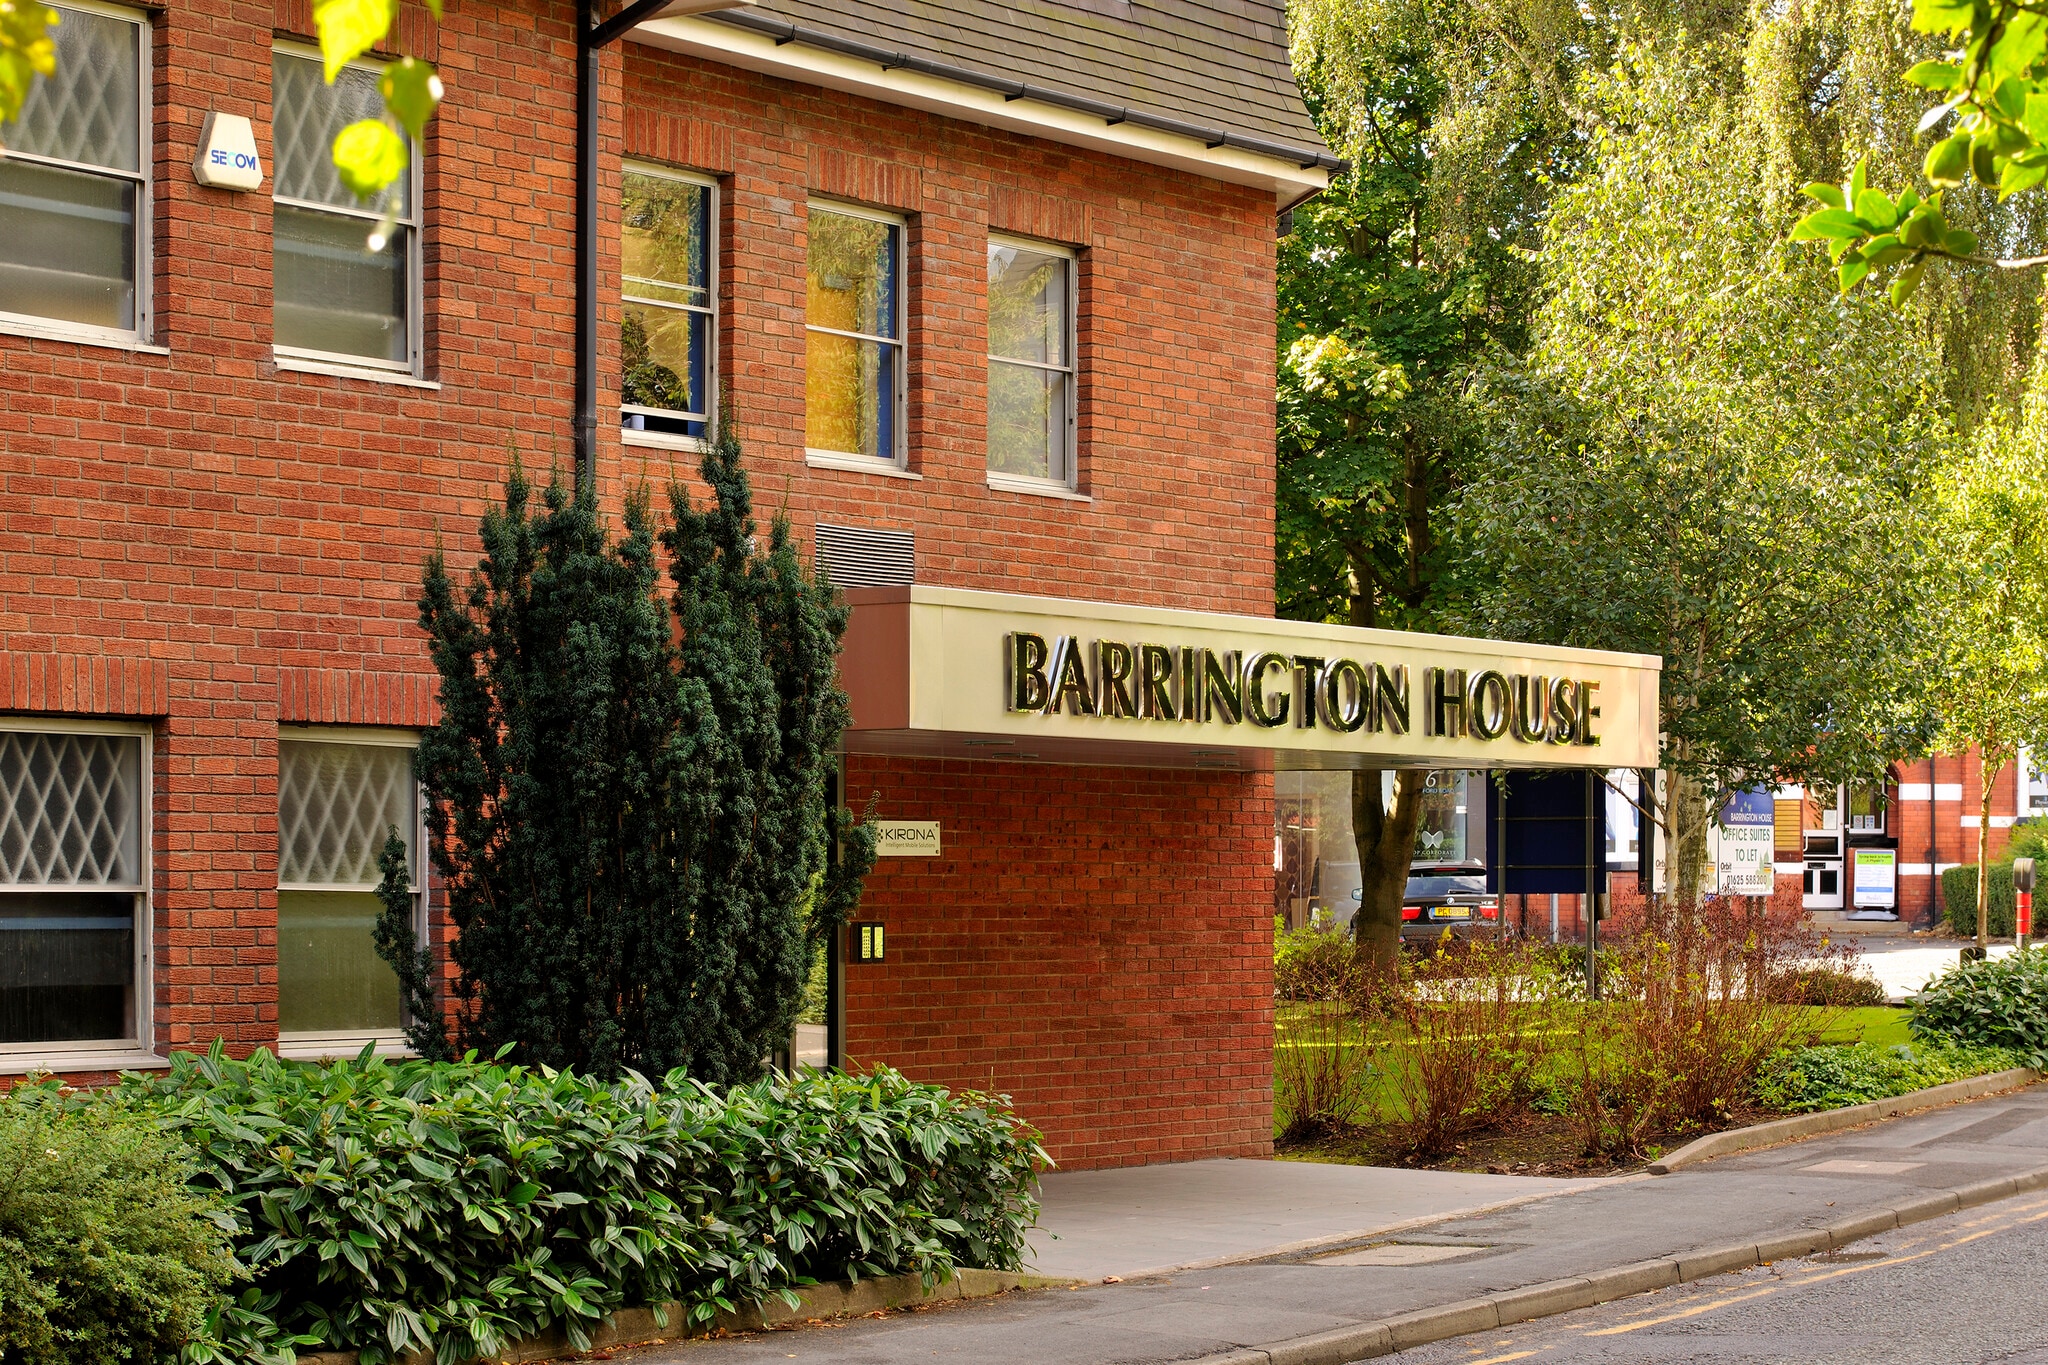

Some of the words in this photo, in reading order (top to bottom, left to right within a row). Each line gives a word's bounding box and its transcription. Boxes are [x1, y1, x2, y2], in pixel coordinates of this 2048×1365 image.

[211, 150, 256, 170] SECOM
[1010, 631, 1410, 737] BARRINGTON
[1425, 666, 1601, 746] HOUSE
[1425, 770, 1439, 787] 6
[1730, 812, 1758, 822] BARRINGTON
[1758, 814, 1772, 822] HOUSE
[885, 828, 935, 840] KIRONA
[1722, 828, 1747, 841] OFFICE
[1749, 828, 1770, 841] SUITES
[1735, 848, 1745, 861] TO
[1747, 848, 1757, 861] LET
[1720, 862, 1732, 870] Orbit
[1727, 875, 1744, 885] 01625
